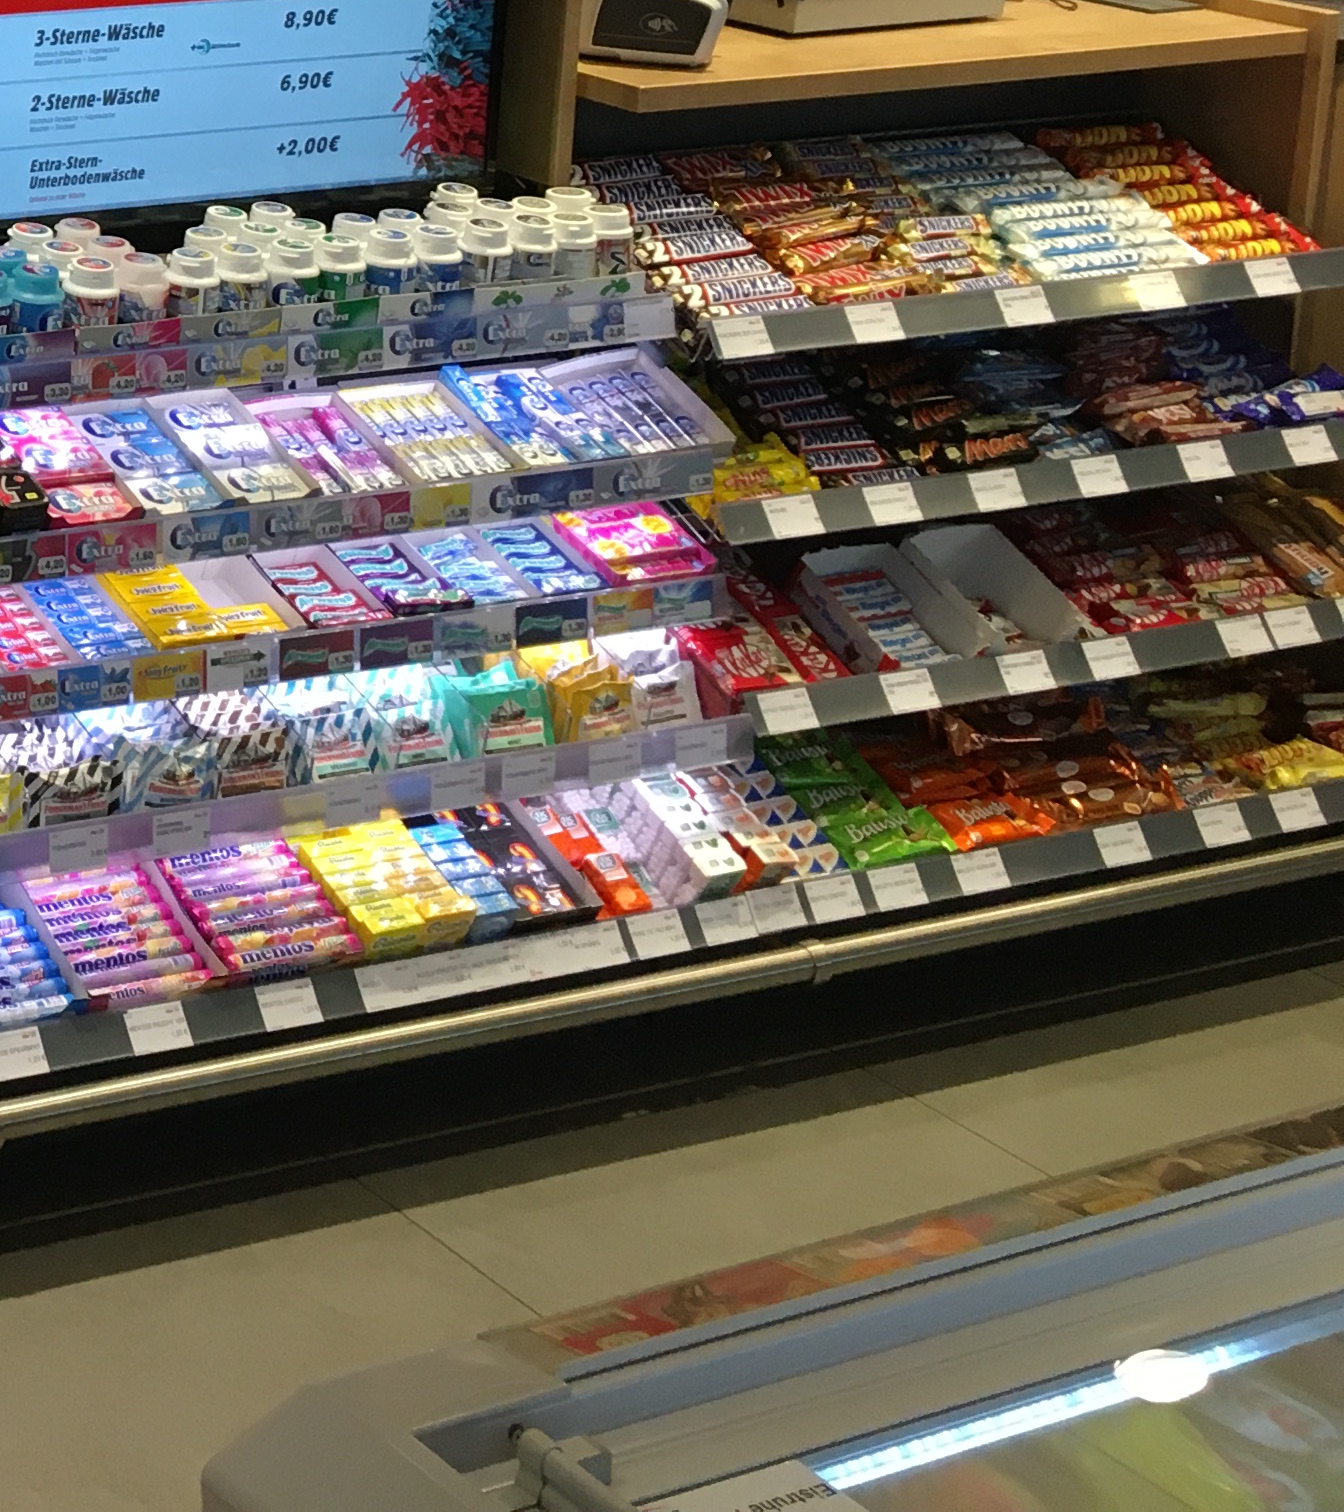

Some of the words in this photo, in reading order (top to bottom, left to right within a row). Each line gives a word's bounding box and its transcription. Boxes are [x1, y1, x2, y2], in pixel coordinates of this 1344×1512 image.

[34, 19, 166, 49] 3-Sterne-Wäsche
[283, 7, 339, 32] 8,90€
[29, 84, 161, 115] 2-Sterne-Wäsche
[279, 71, 334, 93] 6,90€
[29, 153, 104, 174] Extra-Stern-
[275, 135, 341, 157] +2,00€
[28, 164, 146, 192] Unterbodenwäsche
[73, 949, 148, 974] mentos
[239, 940, 314, 965] mentos
